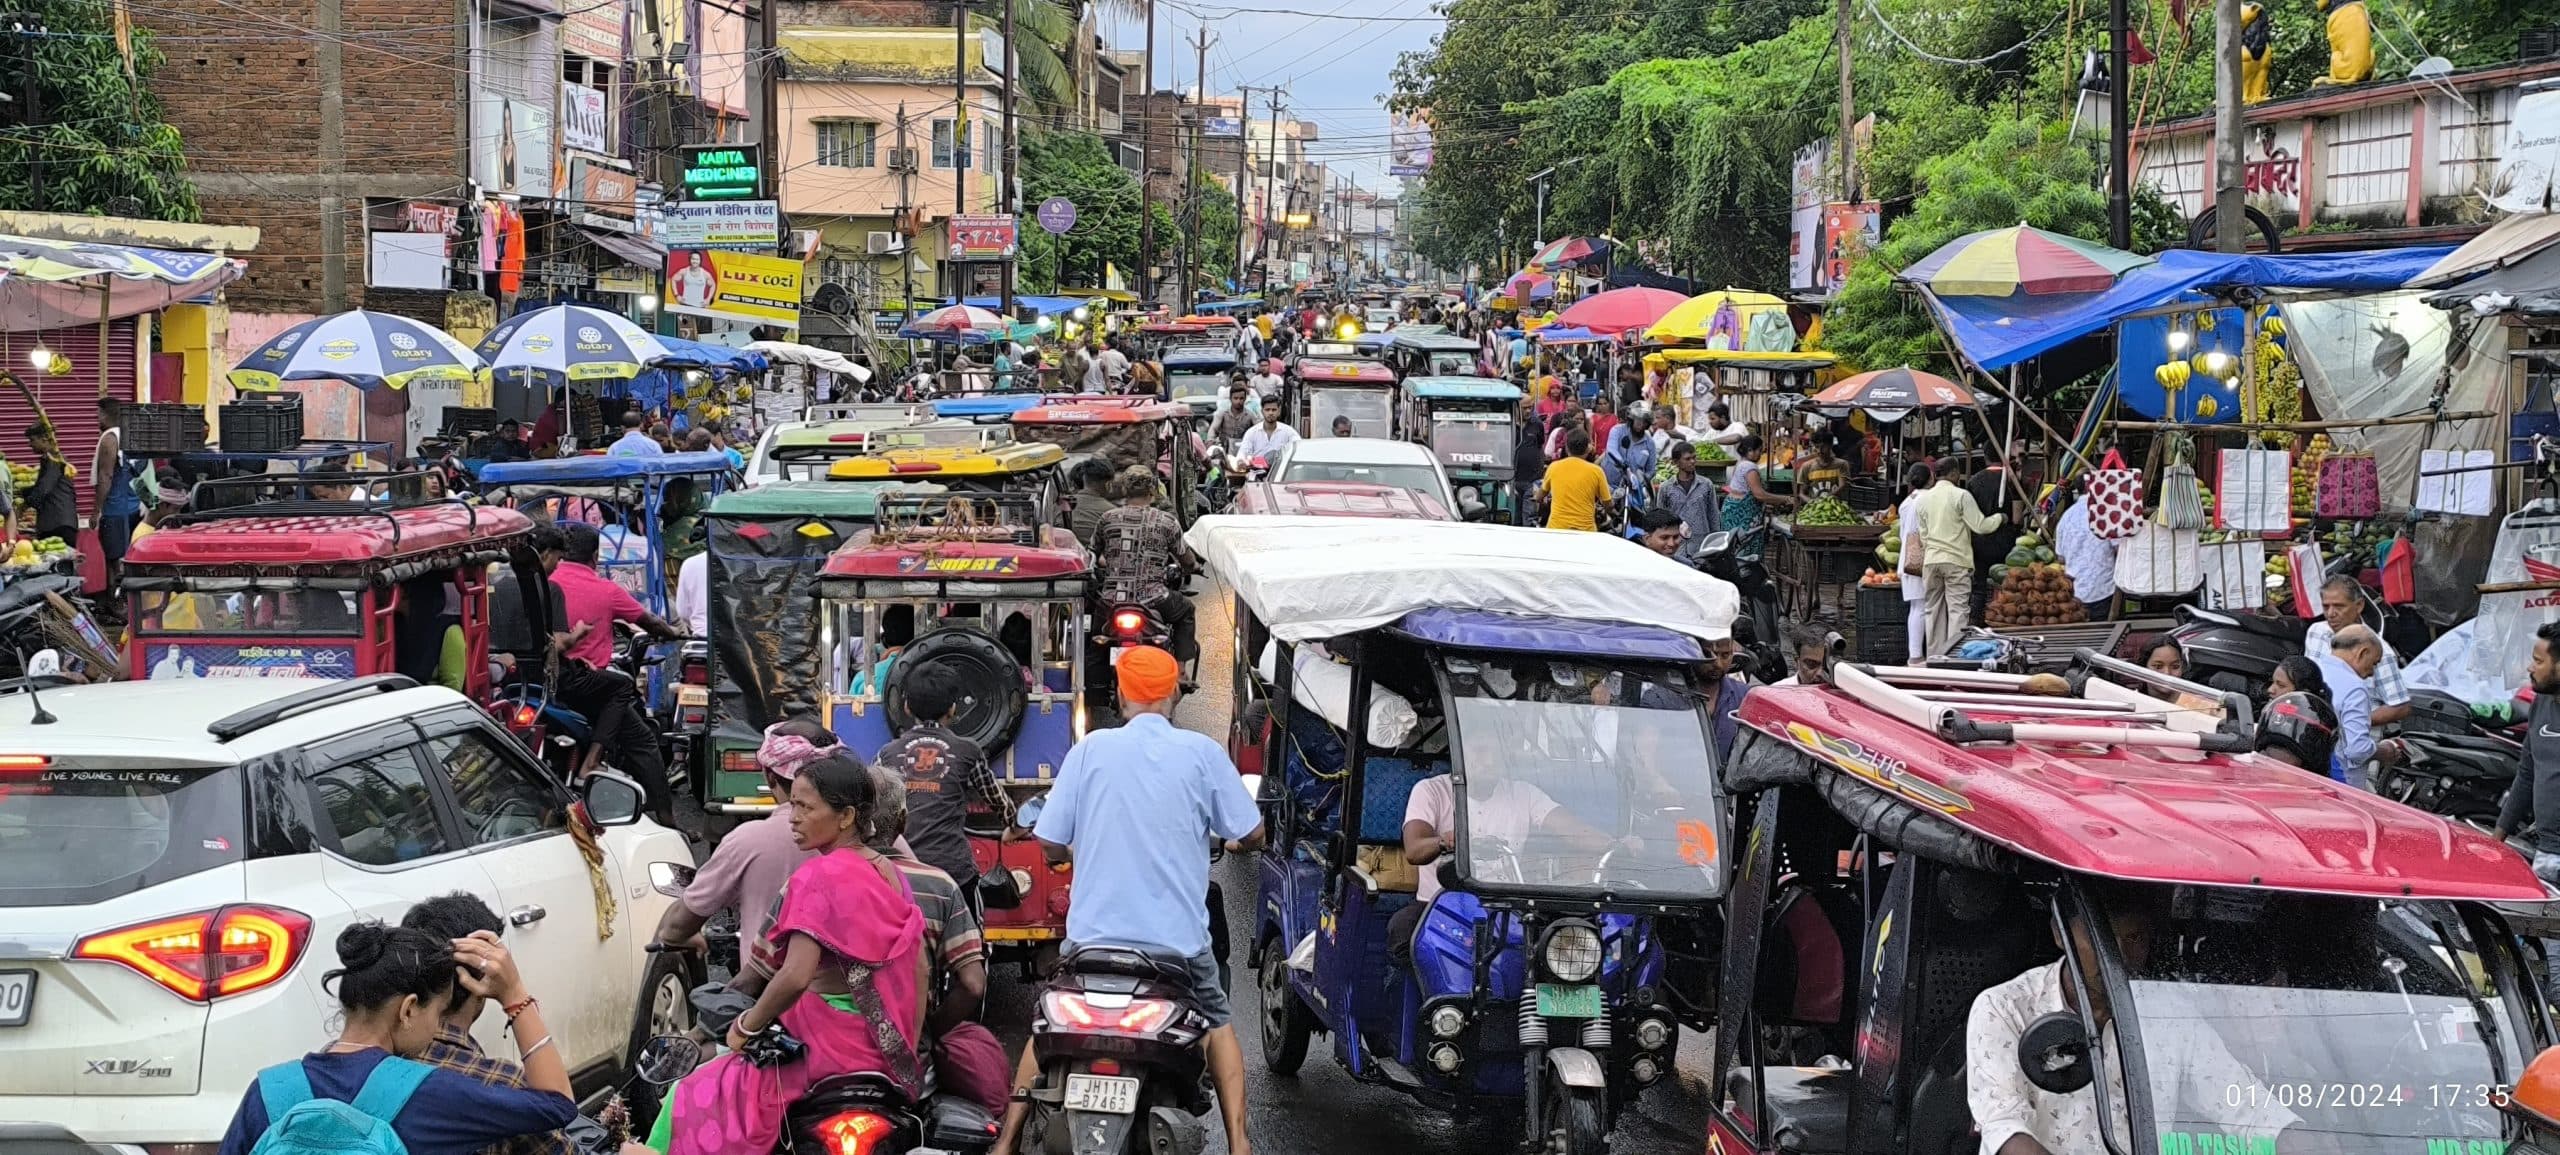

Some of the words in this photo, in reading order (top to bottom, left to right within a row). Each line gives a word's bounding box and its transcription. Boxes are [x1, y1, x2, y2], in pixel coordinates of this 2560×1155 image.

[698, 151, 745, 164] KABITA
[684, 167, 758, 182] MEDICINES
[723, 269, 760, 283] LUX
[763, 274, 794, 288] cozi
[392, 348, 432, 359] Rotary
[576, 342, 613, 351] Rotary
[1449, 453, 1494, 464] TIGER
[41, 773, 67, 781] LIVE
[119, 772, 145, 781] LIVE
[0, 983, 23, 1011] 0
[138, 1067, 172, 1078] 300
[1084, 1079, 1127, 1096] JH11A
[1082, 1094, 1126, 1111] B7463
[2161, 1131, 2193, 1155] MD
[2427, 1138, 2463, 1155] MD
